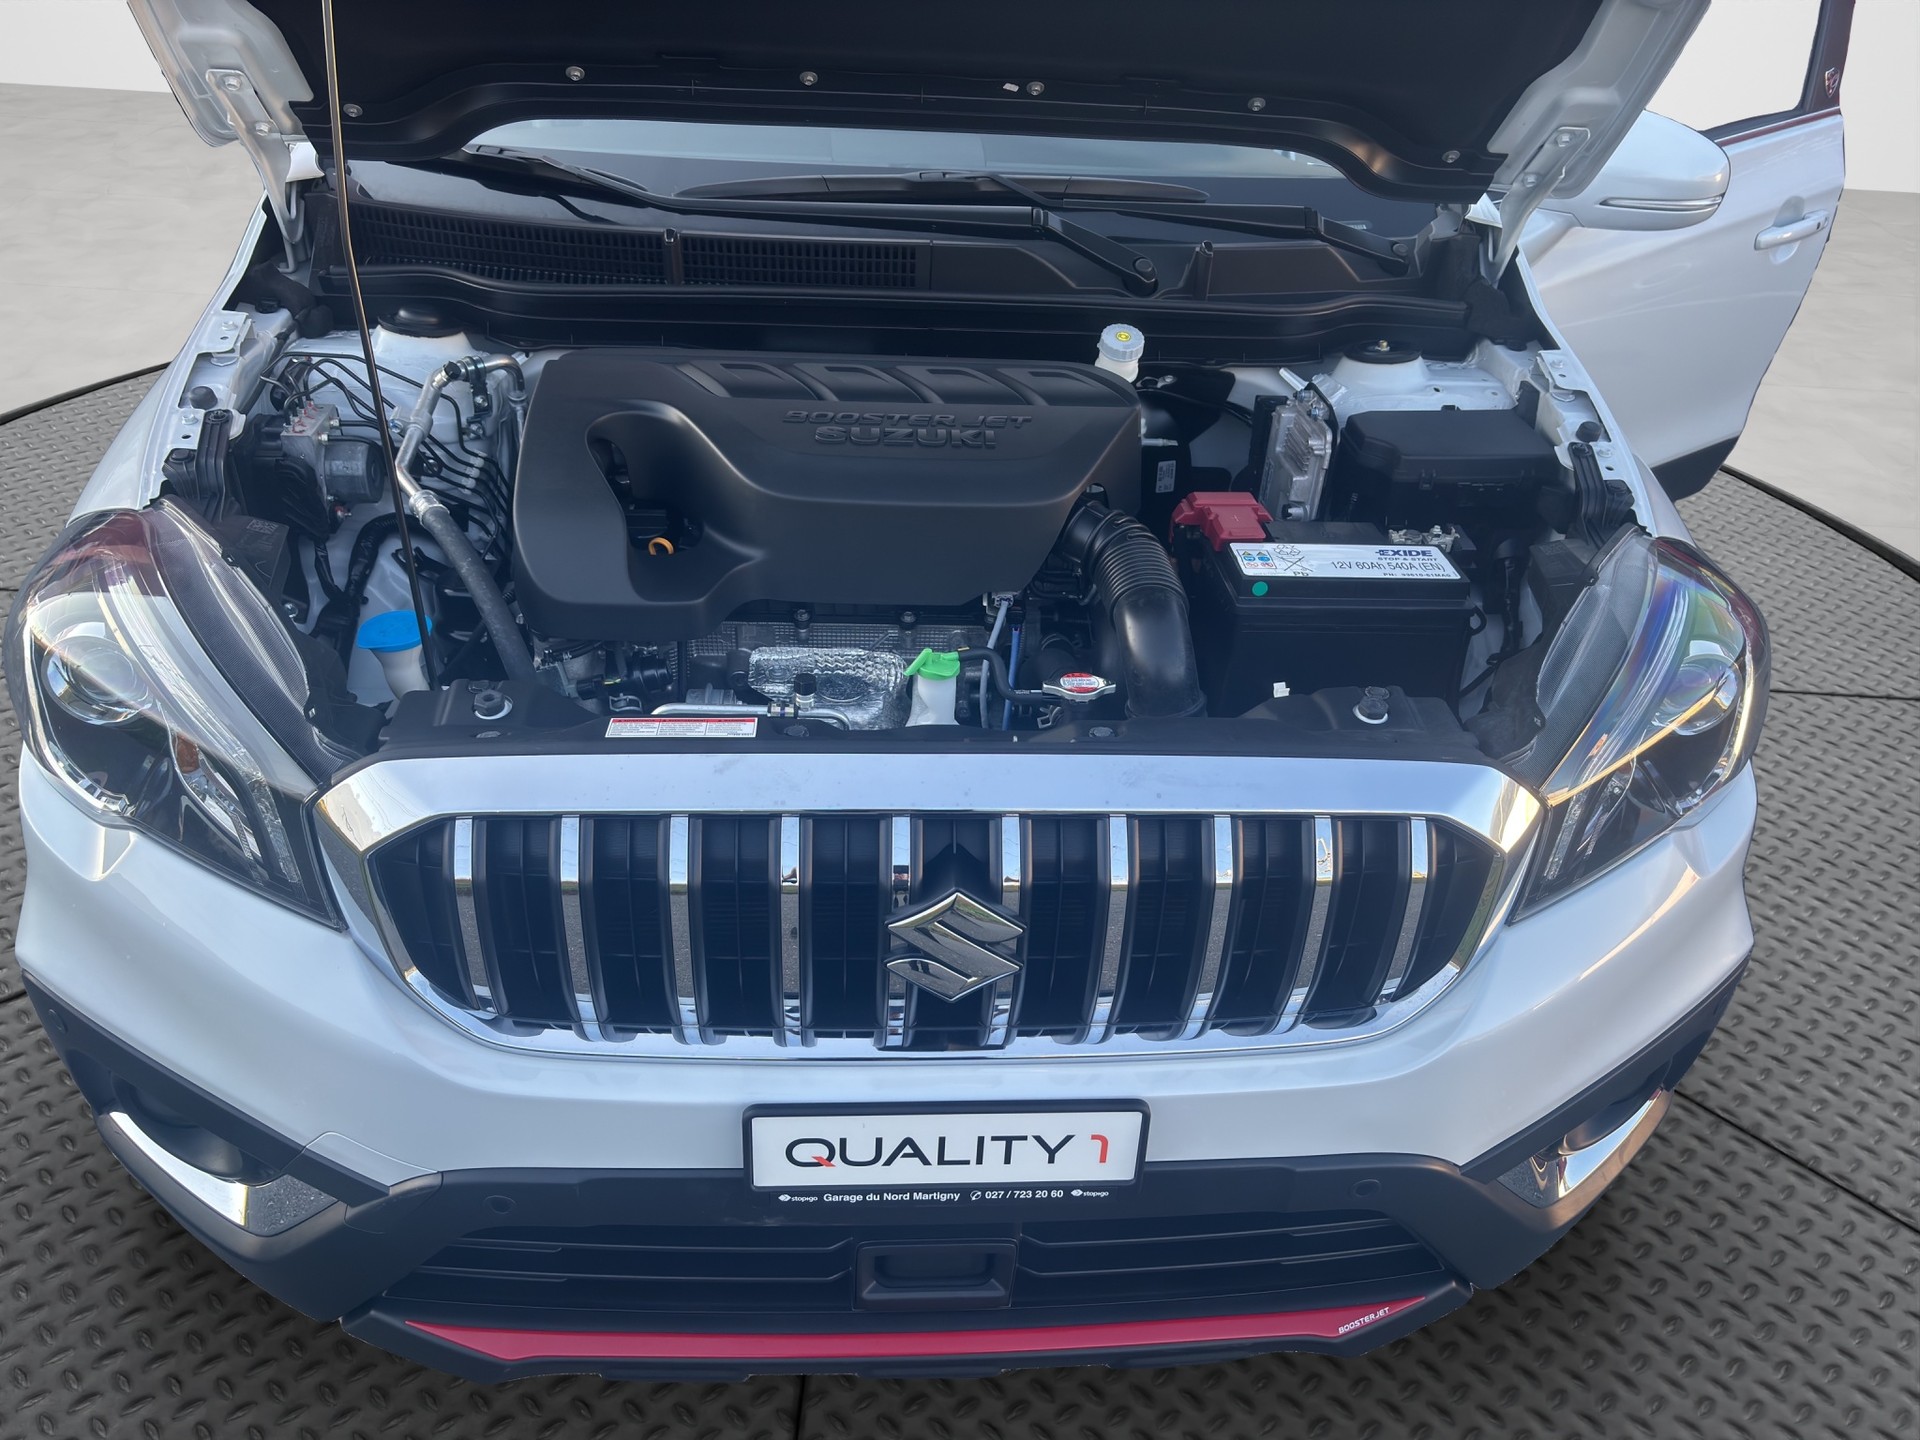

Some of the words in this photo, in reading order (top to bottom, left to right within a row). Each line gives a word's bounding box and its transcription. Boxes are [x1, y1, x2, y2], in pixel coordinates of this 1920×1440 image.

[814, 426, 997, 448] SUZUKI
[1378, 549, 1433, 557] EXIDE
[1331, 561, 1352, 570] 12V
[1355, 561, 1387, 570] 60Ah
[1387, 561, 1418, 571] 540A
[1419, 562, 1446, 572] (EN)
[785, 1134, 1076, 1168] QUALITY
[1090, 1134, 1109, 1164] 1
[823, 1193, 863, 1203] Garage
[866, 1193, 880, 1202] du
[883, 1192, 910, 1201] Nord
[912, 1191, 961, 1202] Martigny
[985, 1190, 1005, 1199] 027
[1013, 1190, 1033, 1199] 723
[1035, 1189, 1048, 1198] 20
[1050, 1189, 1064, 1198] 60
